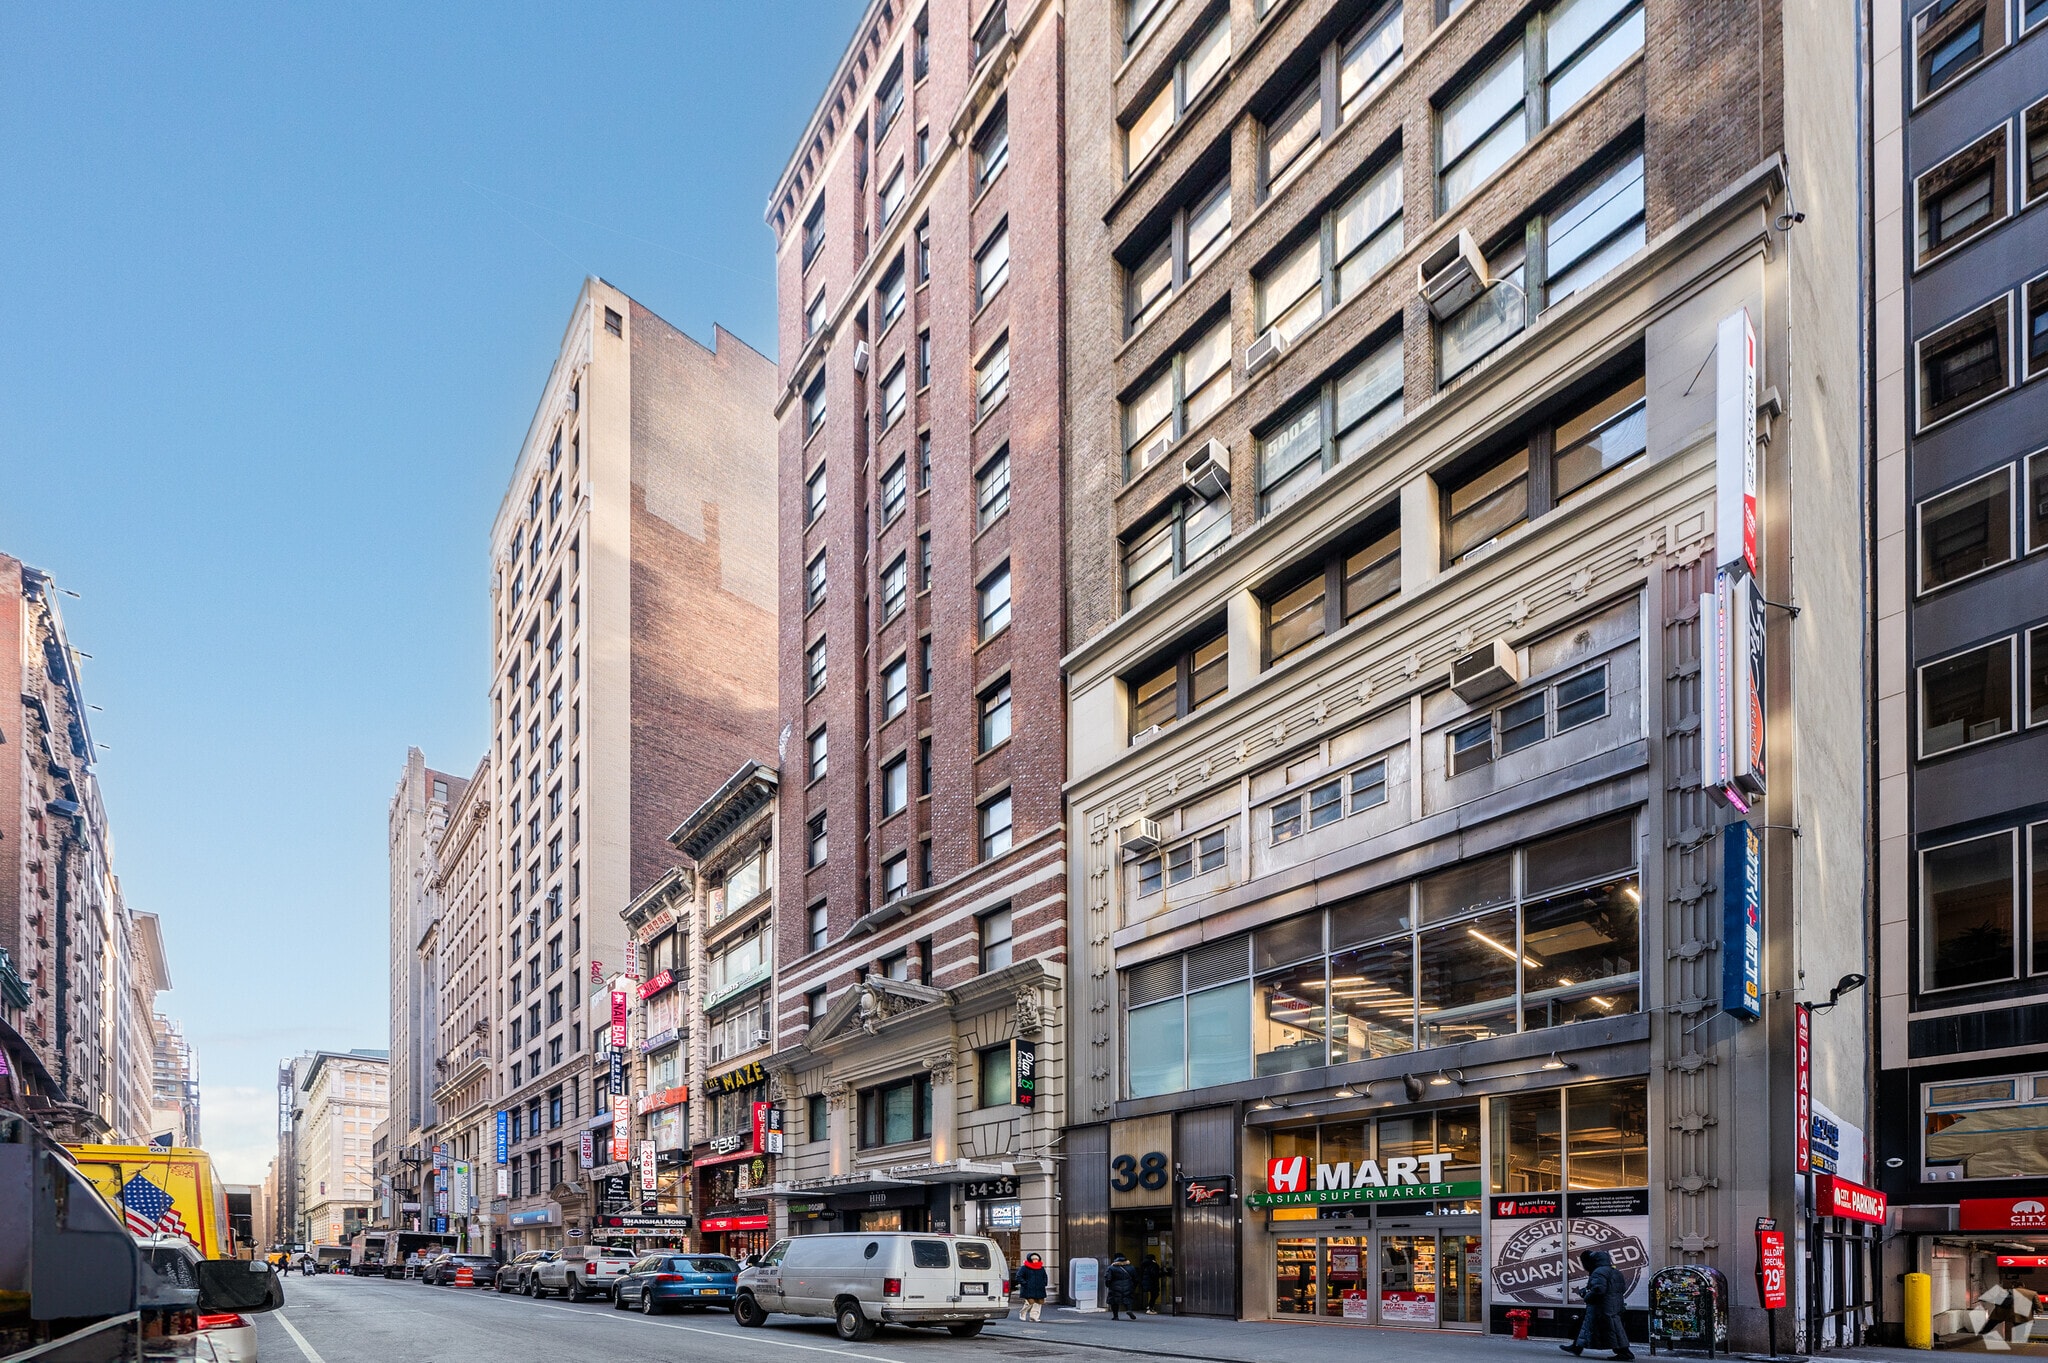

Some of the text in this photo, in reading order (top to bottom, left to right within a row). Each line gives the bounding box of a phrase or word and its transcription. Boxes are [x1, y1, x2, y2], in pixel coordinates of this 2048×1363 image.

[656, 972, 673, 988] BAR
[613, 1003, 625, 1024] NAIL
[612, 1025, 625, 1045] BAR
[704, 1060, 765, 1091] THE MAZE
[1021, 1052, 1034, 1090] Plan B
[1020, 1095, 1032, 1104] 2F
[1800, 1045, 1808, 1141] PARK
[615, 1097, 628, 1123] SPA
[498, 1122, 506, 1161] THE SPA CLUB
[642, 1150, 655, 1189] 상하이몽
[1111, 1151, 1168, 1192] 38
[1272, 1153, 1453, 1192] H MART
[970, 1181, 1014, 1197] 34-36
[1266, 1184, 1454, 1204] ASIAN SUPERMARKET
[1840, 1189, 1850, 1201] CITY
[1500, 1201, 1515, 1215] H
[1518, 1205, 1557, 1215] MART
[1852, 1191, 1878, 1217] PARKING
[622, 1217, 663, 1225] SHANGHAI
[2010, 1214, 2047, 1222] CITY
[1506, 1219, 1612, 1261] FRESHNESS
[1764, 1248, 1783, 1257] ALL DAY
[1764, 1258, 1783, 1266] SPECIAL
[1499, 1244, 1641, 1287] GUARANED
[1765, 1268, 1781, 1291] 29
